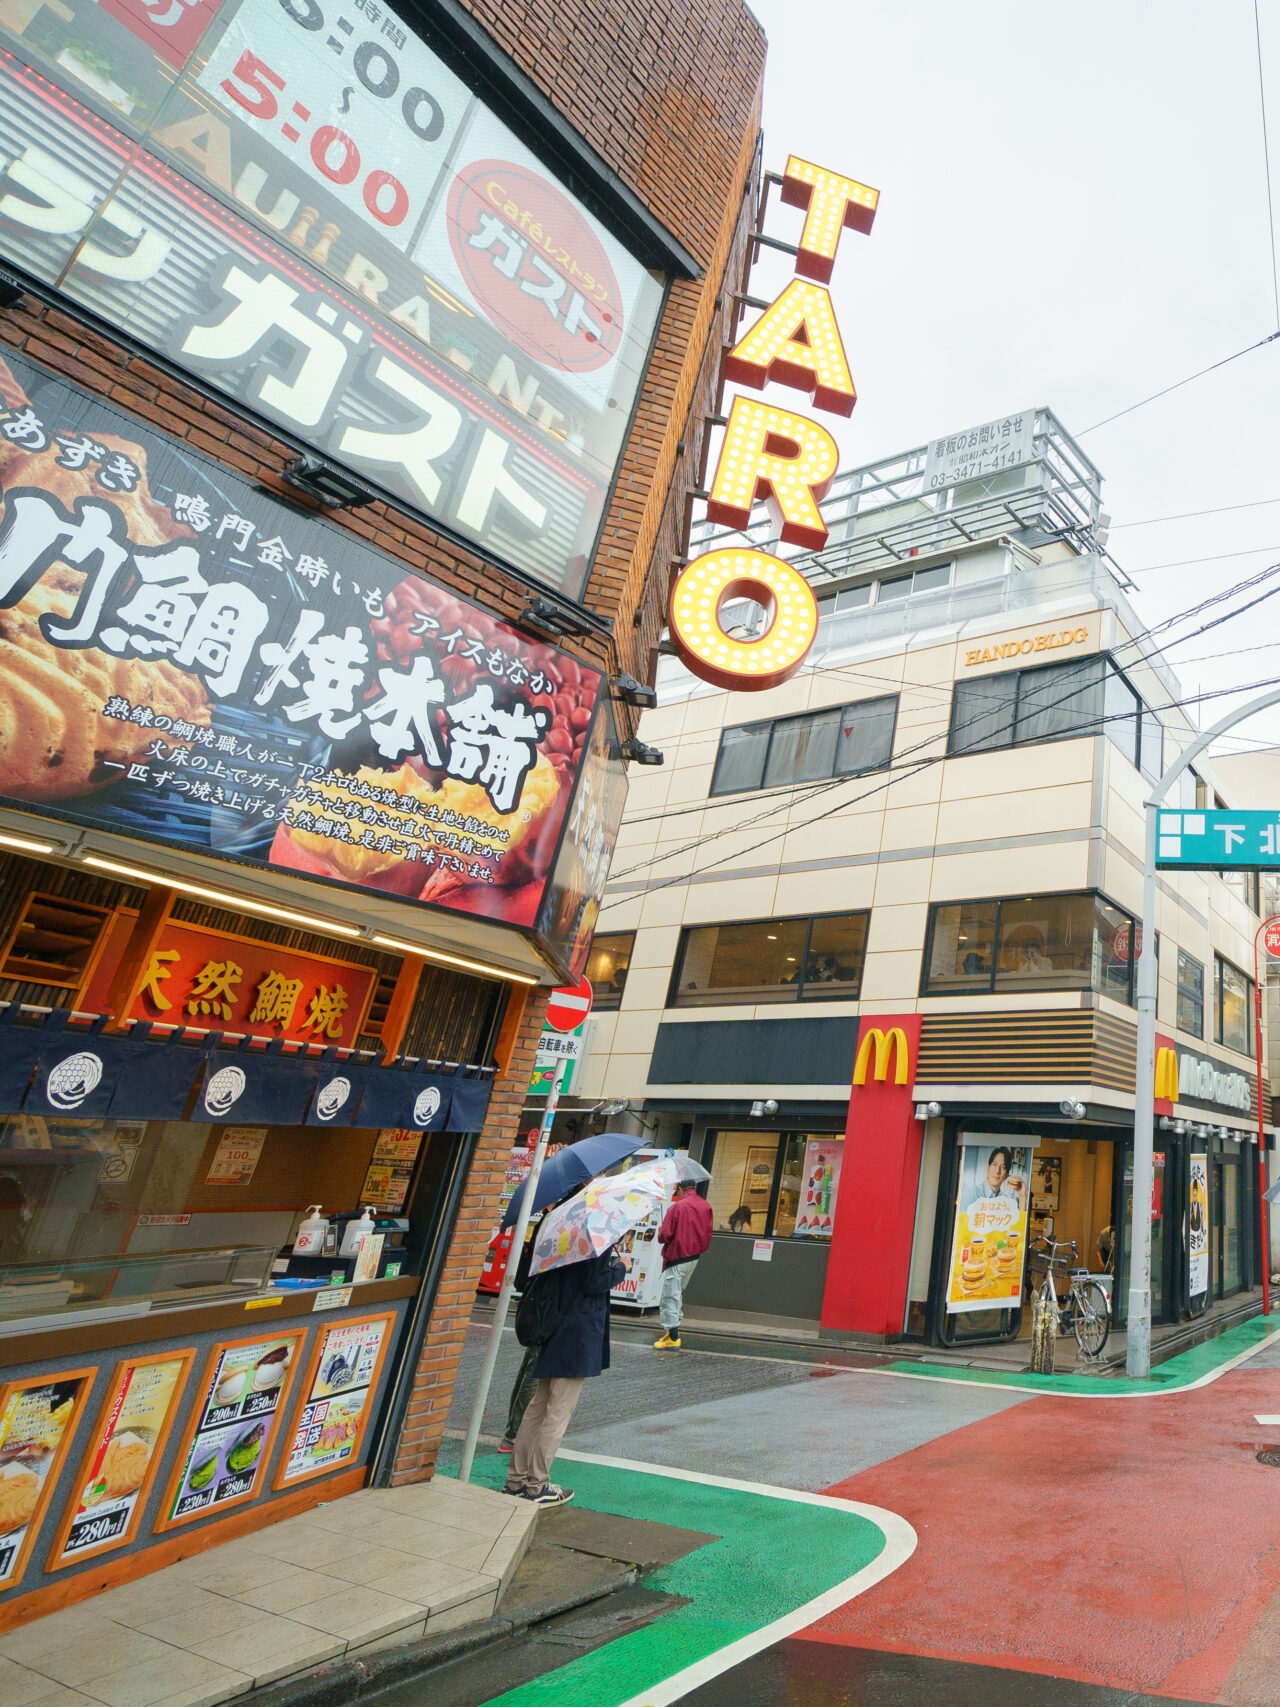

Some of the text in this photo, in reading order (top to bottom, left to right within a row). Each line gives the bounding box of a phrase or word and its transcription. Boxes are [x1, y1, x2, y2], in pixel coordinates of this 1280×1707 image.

[220, 47, 410, 228] 5:00
[468, 212, 604, 341] ガスト
[181, 264, 549, 537] ガスト
[669, 154, 881, 692] TARO
[930, 448, 1023, 489] 03-3471-4141
[2, 408, 555, 695] あずき 鳴門金時いも アイスもなか
[965, 627, 1088, 666] HANDO BLDG
[138, 948, 350, 1040] 天然鯛焼
[538, 1037, 579, 1055] 自転車を除く
[1178, 1053, 1252, 1112] McDonald's
[974, 1213, 1013, 1229] 朝マック
[980, 1201, 1011, 1211] おはよう。
[612, 1279, 638, 1293] RIN
